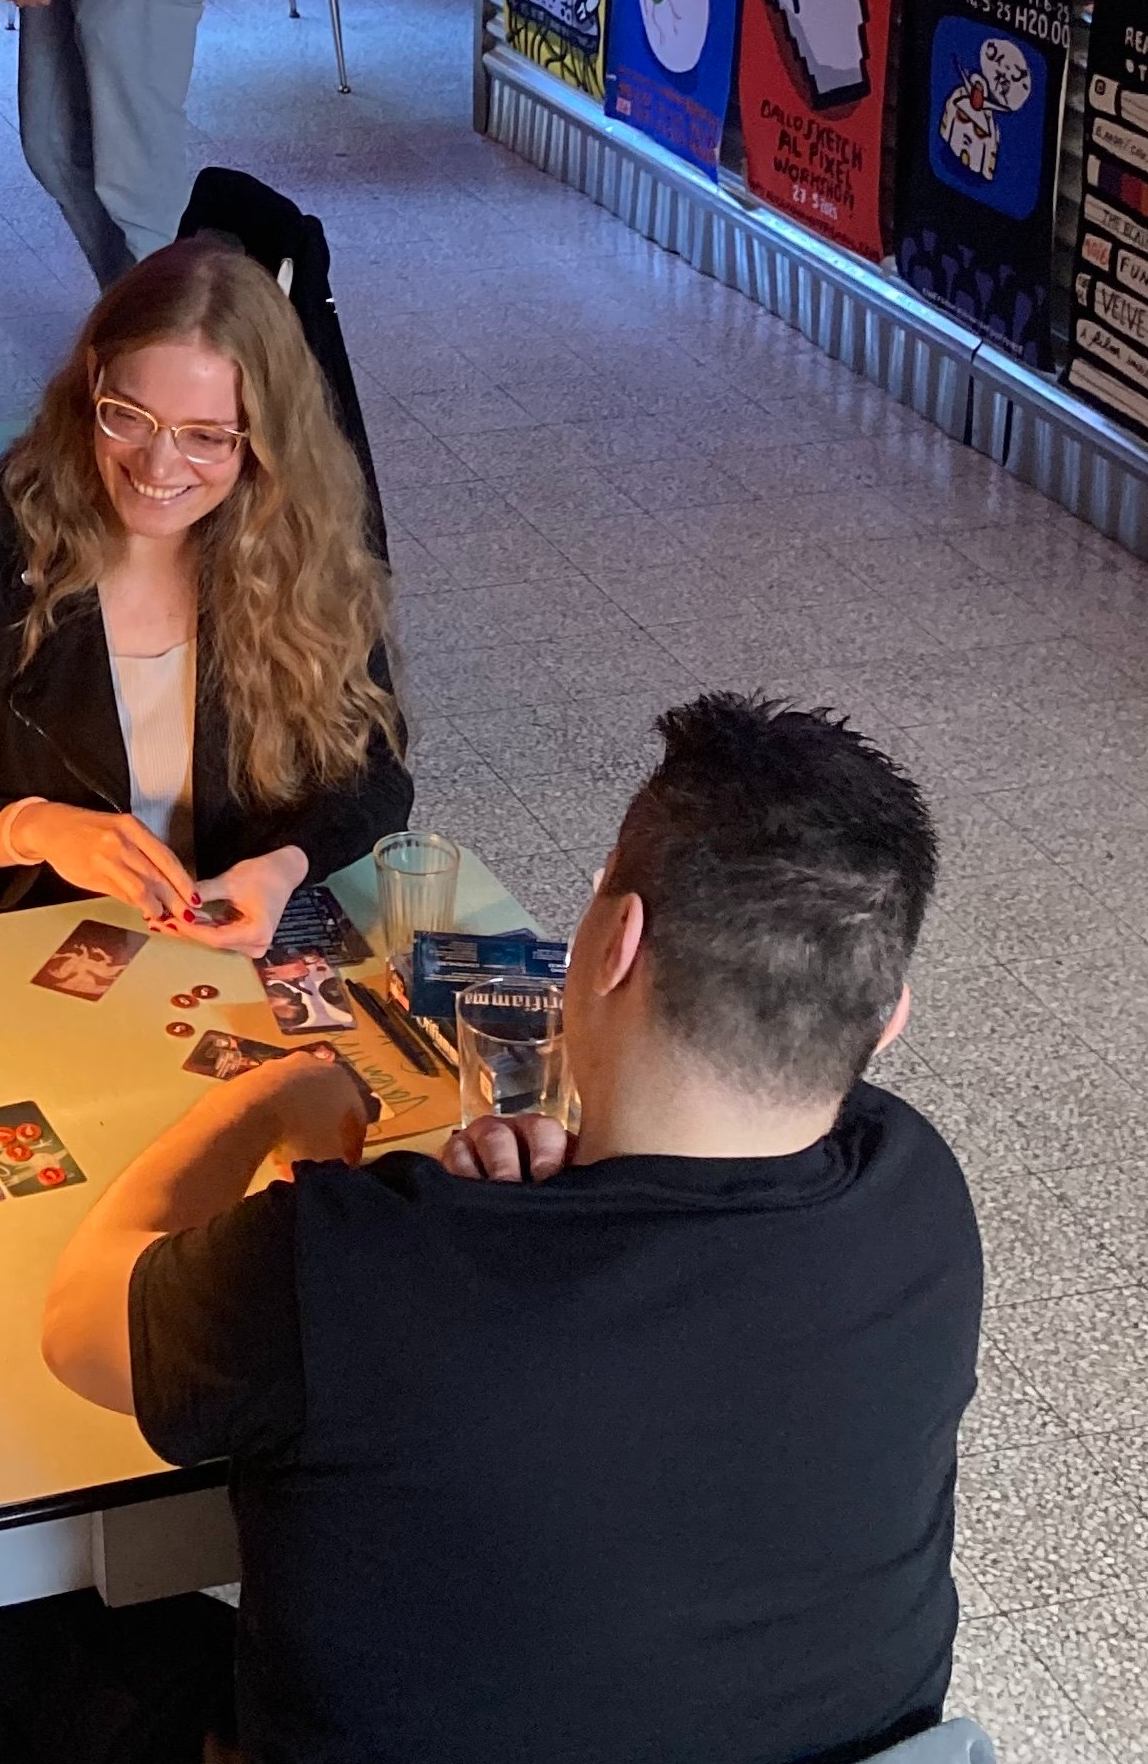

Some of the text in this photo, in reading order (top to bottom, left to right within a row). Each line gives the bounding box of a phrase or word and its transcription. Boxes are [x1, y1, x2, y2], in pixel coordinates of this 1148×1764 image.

[778, 129, 852, 188] AL PIXEL
[804, 119, 863, 172] SKETCH
